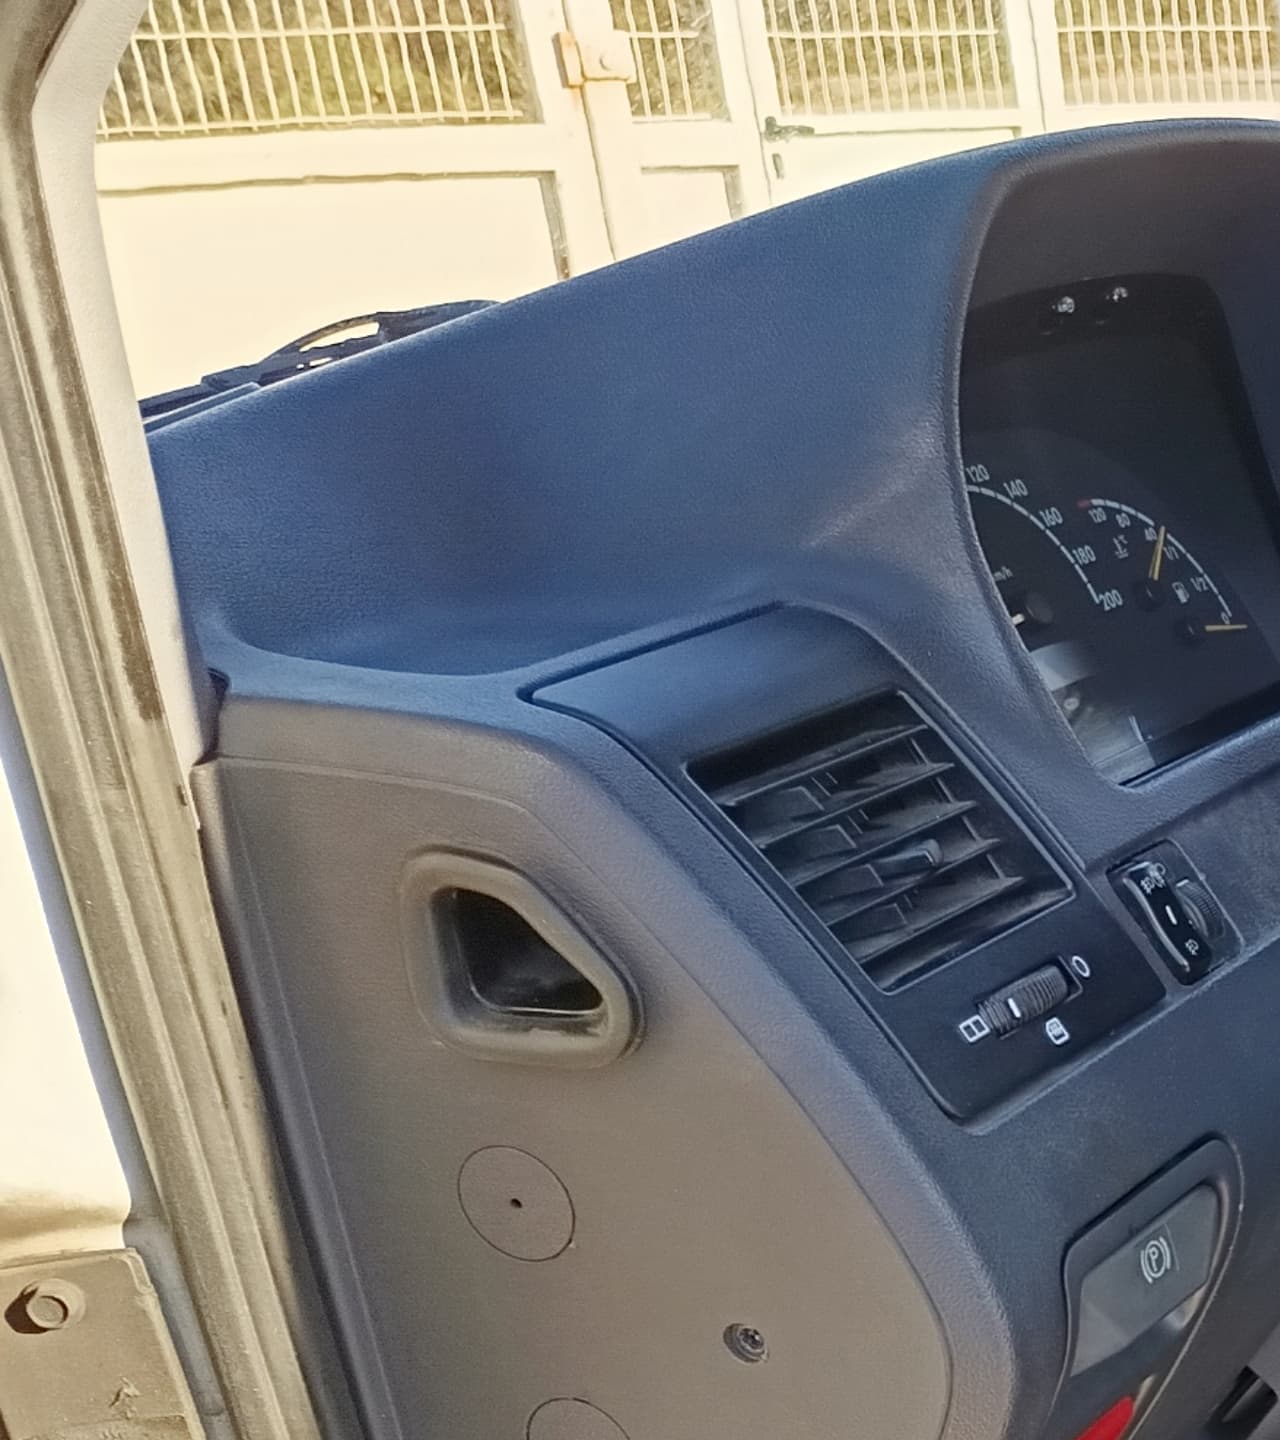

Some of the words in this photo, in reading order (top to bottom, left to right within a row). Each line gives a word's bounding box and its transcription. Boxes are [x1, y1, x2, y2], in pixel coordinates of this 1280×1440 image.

[966, 464, 990, 482] 120
[1003, 479, 1028, 498] 140
[1039, 507, 1064, 527] 160
[1088, 507, 1107, 524] 120
[1073, 545, 1096, 565] 180
[1190, 577, 1209, 592] 1/2
[1100, 589, 1123, 611] 200
